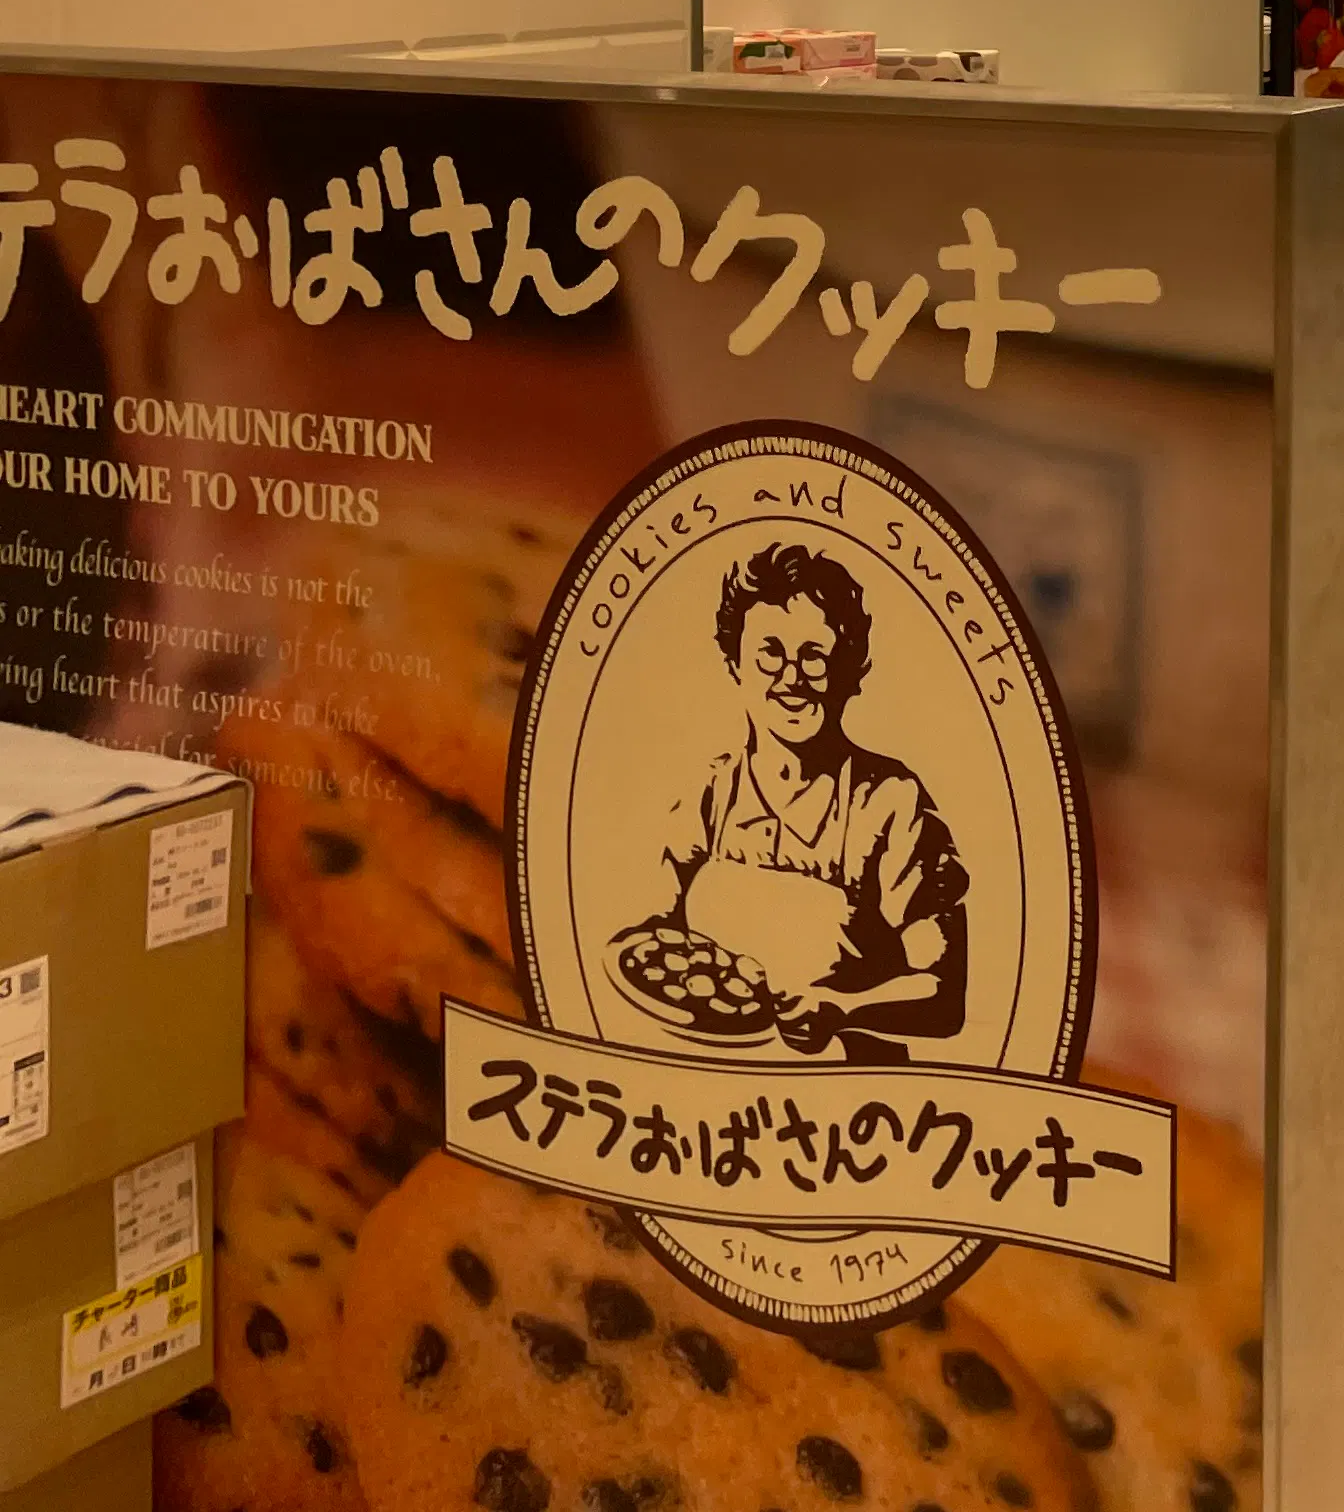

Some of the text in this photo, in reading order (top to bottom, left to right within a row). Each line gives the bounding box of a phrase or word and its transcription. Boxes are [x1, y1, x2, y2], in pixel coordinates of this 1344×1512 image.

[113, 395, 434, 464] COMMUNICATION
[0, 449, 380, 529] UR HOME TO YOURS
[0, 529, 374, 609] aking delicious cookies is not the
[580, 475, 1016, 708] cookies and sweets
[16, 605, 44, 627] or
[52, 596, 93, 636] the
[103, 610, 268, 661] temperature
[278, 626, 306, 680] of
[315, 628, 358, 670] the
[52, 654, 120, 701] heart
[128, 666, 183, 710] that
[191, 688, 283, 731] aspires
[468, 1059, 1144, 1207] ステラおばさんのクッキー
[721, 1237, 909, 1286] since 1974
